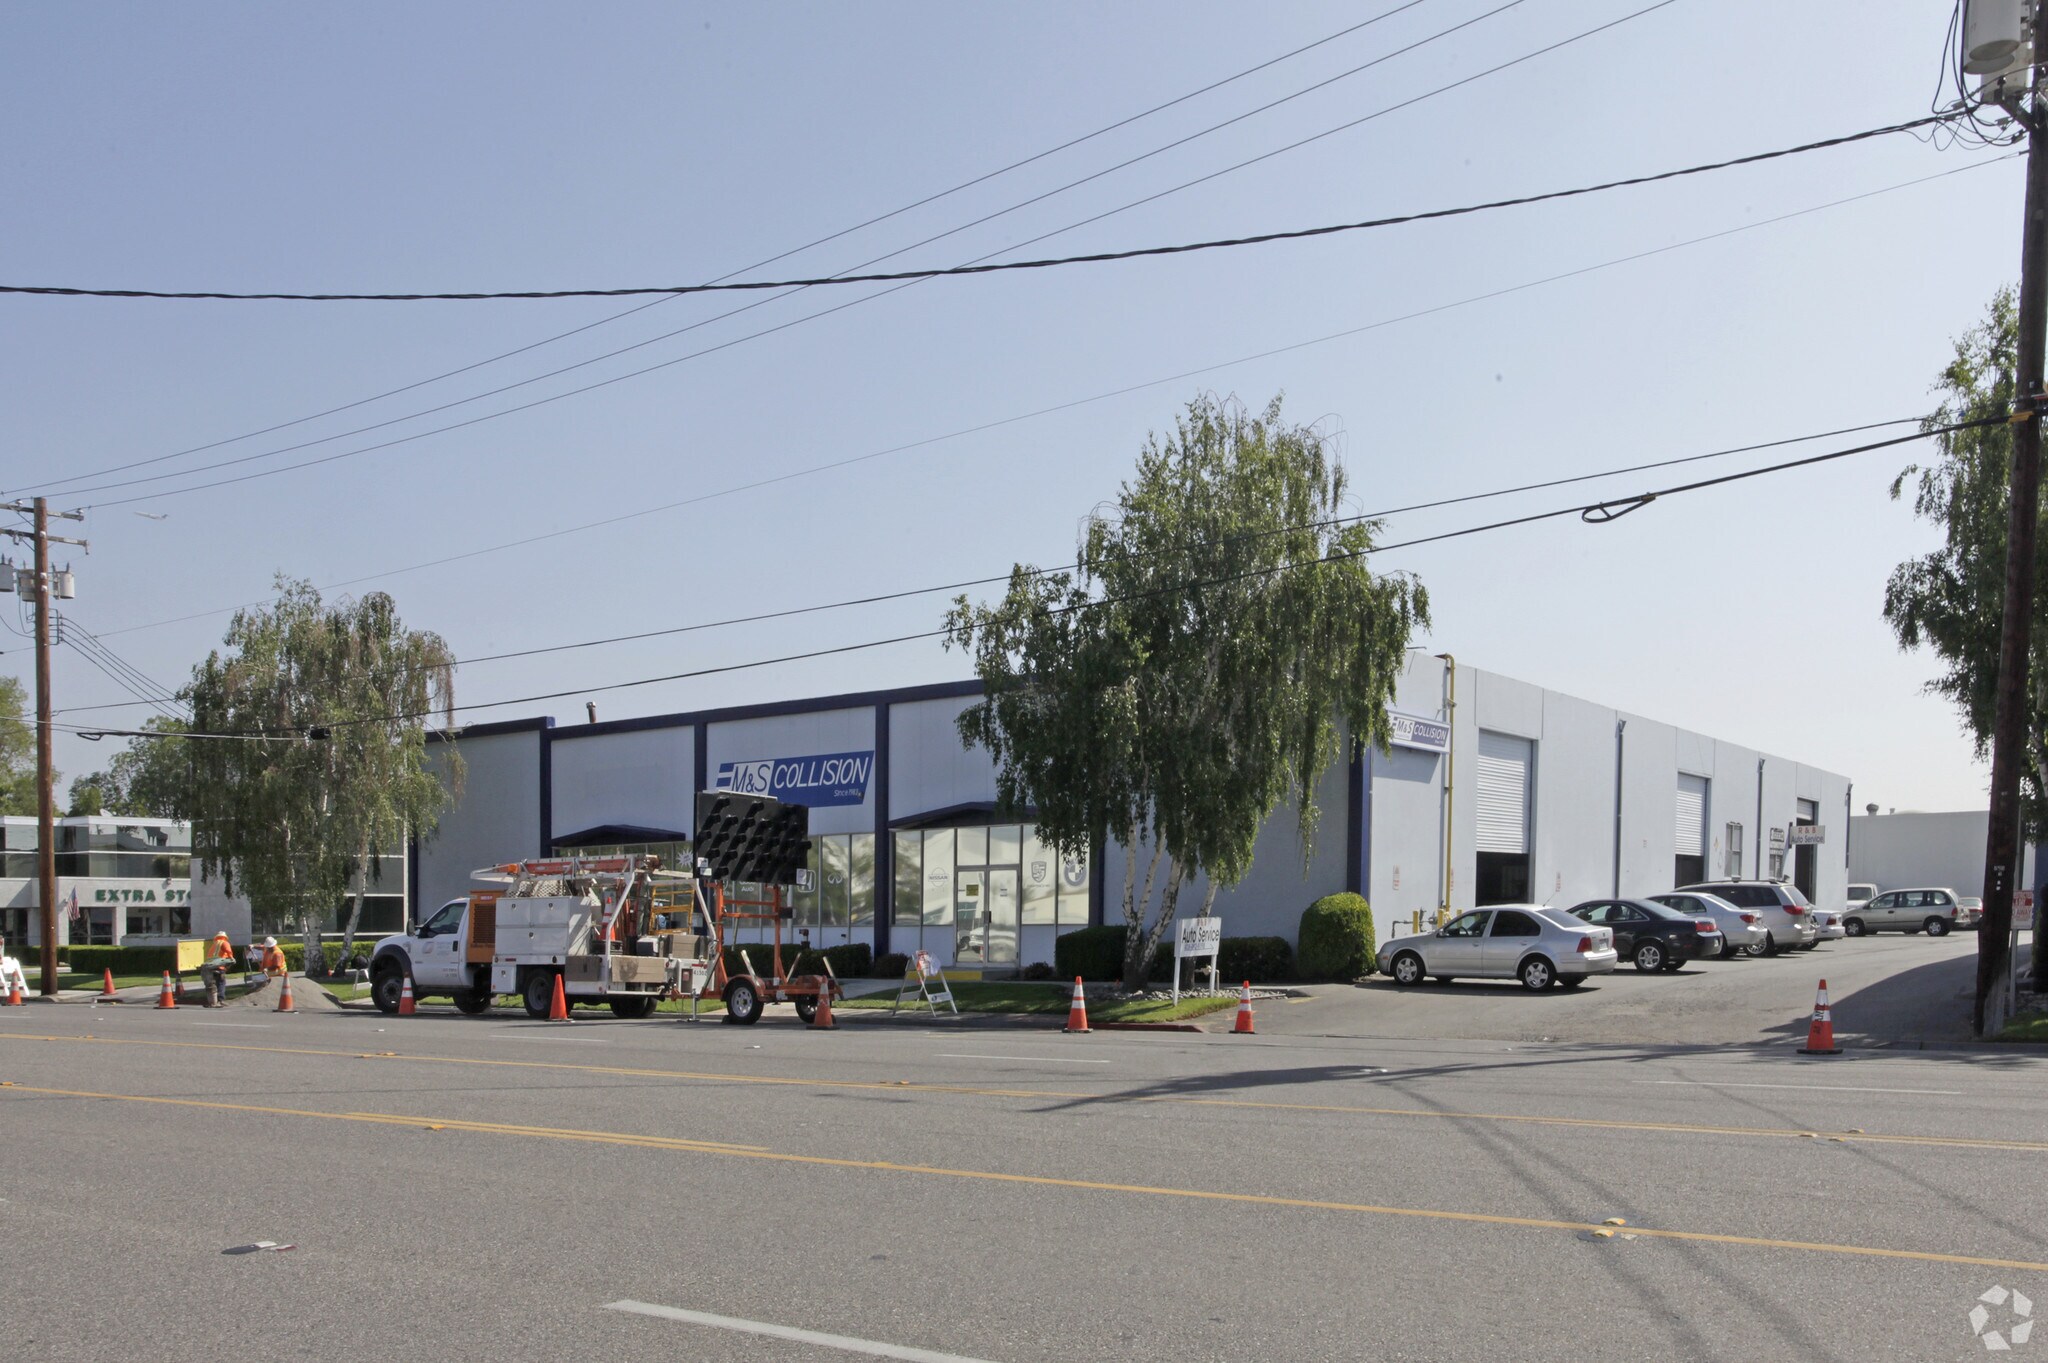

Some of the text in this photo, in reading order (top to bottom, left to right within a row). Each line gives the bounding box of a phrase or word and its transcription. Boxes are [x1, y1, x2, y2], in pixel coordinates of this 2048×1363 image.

[1397, 720, 1447, 741] M&S COLLISION
[731, 757, 869, 793] M&S COLLISION
[834, 790, 848, 798] Since
[1791, 835, 1804, 844] Auto
[1804, 835, 1824, 843] Service
[95, 889, 156, 902] EXTRA
[1182, 926, 1219, 943] Auto Service
